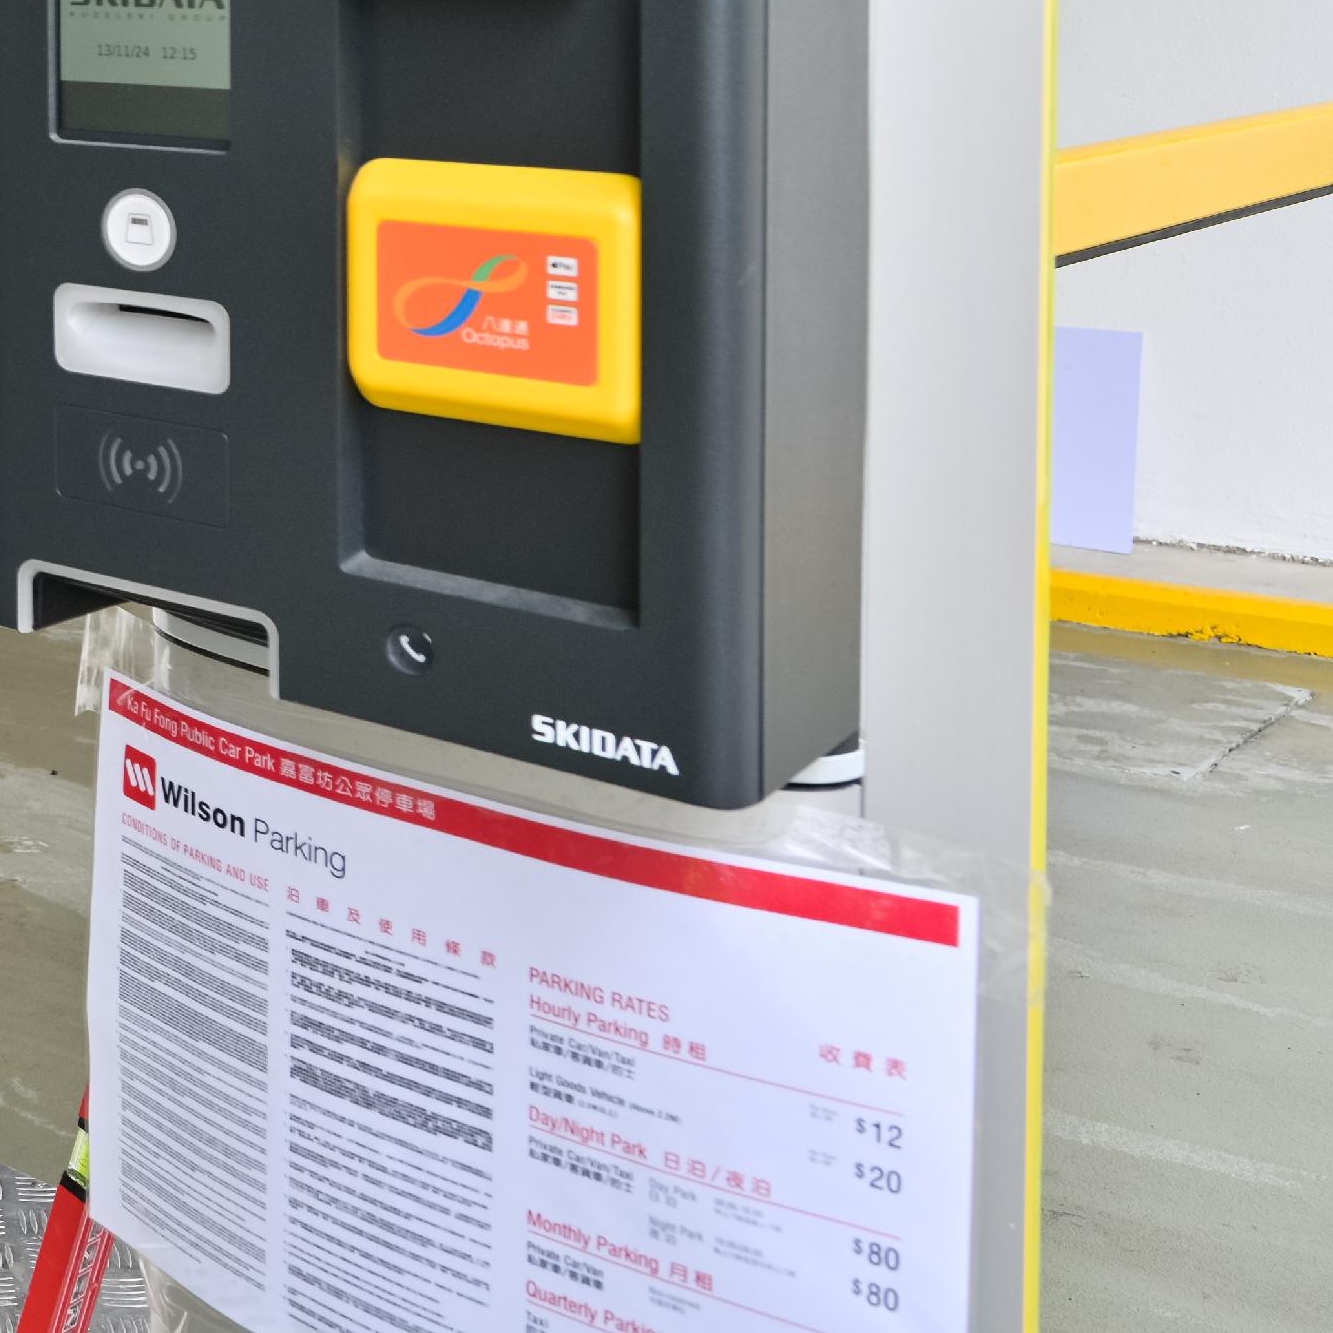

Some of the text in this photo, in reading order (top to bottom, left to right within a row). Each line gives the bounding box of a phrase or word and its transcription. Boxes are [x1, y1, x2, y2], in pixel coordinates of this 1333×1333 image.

[97, 43, 197, 60] 13/11/24 12:15
[461, 327, 530, 350] Octopus
[127, 692, 436, 821] Ka Fu Fong Public Car Park 嘉富坊公眾停車場
[531, 714, 680, 776] SKIDATA
[121, 812, 269, 892] CONDITIONS OF PARKING AND USE
[161, 776, 347, 879] Wilson Parking
[529, 966, 670, 1022] PARKING RATES
[529, 994, 580, 1026] Hourly
[587, 1012, 649, 1047] Parking
[529, 1106, 605, 1146] Day/Night
[611, 1133, 647, 1161] Park
[856, 1117, 902, 1149] $12
[854, 1162, 902, 1194] $20
[527, 1210, 591, 1249] Monthly
[596, 1235, 659, 1275] Parking
[852, 1237, 901, 1271] $80
[526, 1280, 598, 1323] Quarterly
[851, 1277, 900, 1311] $80
